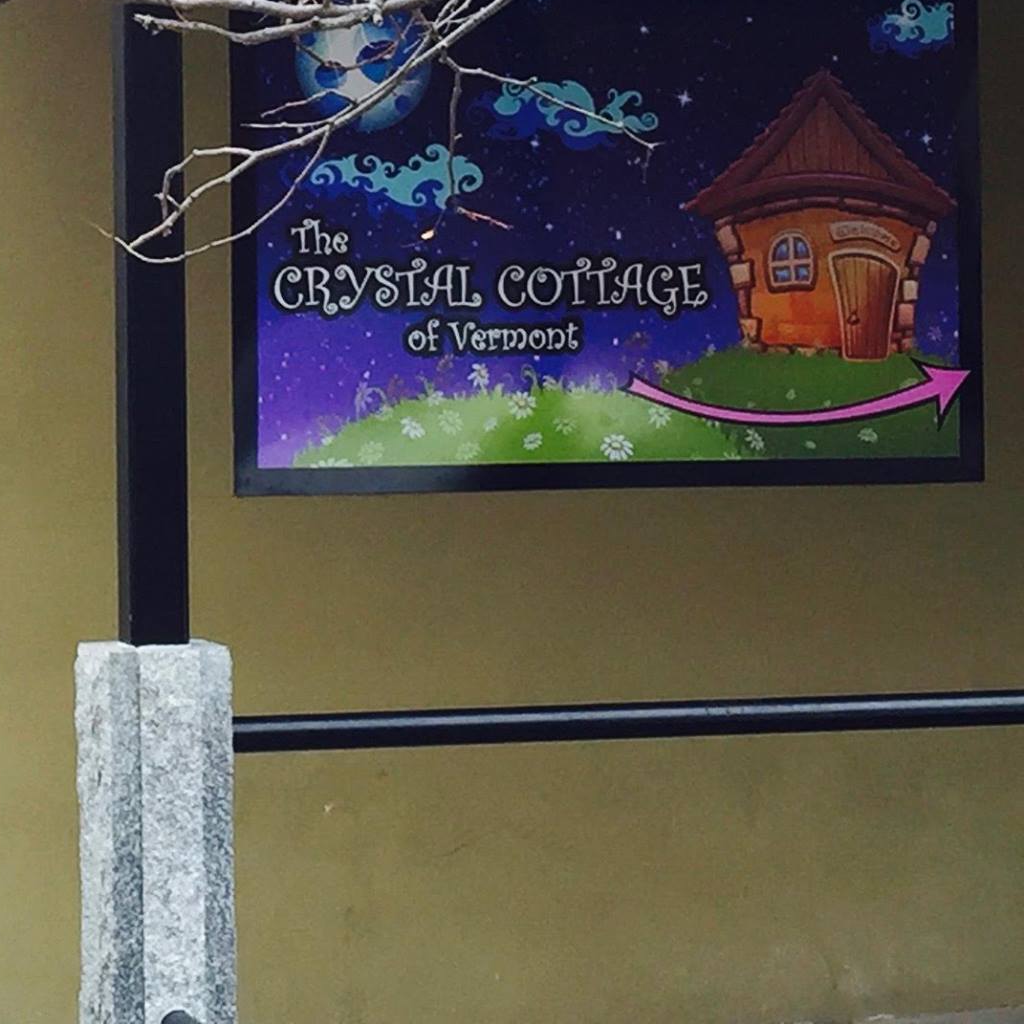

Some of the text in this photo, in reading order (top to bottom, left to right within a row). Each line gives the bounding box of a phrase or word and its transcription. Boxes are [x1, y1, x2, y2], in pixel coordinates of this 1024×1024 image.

[291, 218, 349, 255] The
[274, 256, 708, 315] CRYSTAL COTTAGE
[407, 319, 579, 352] of Vermont
